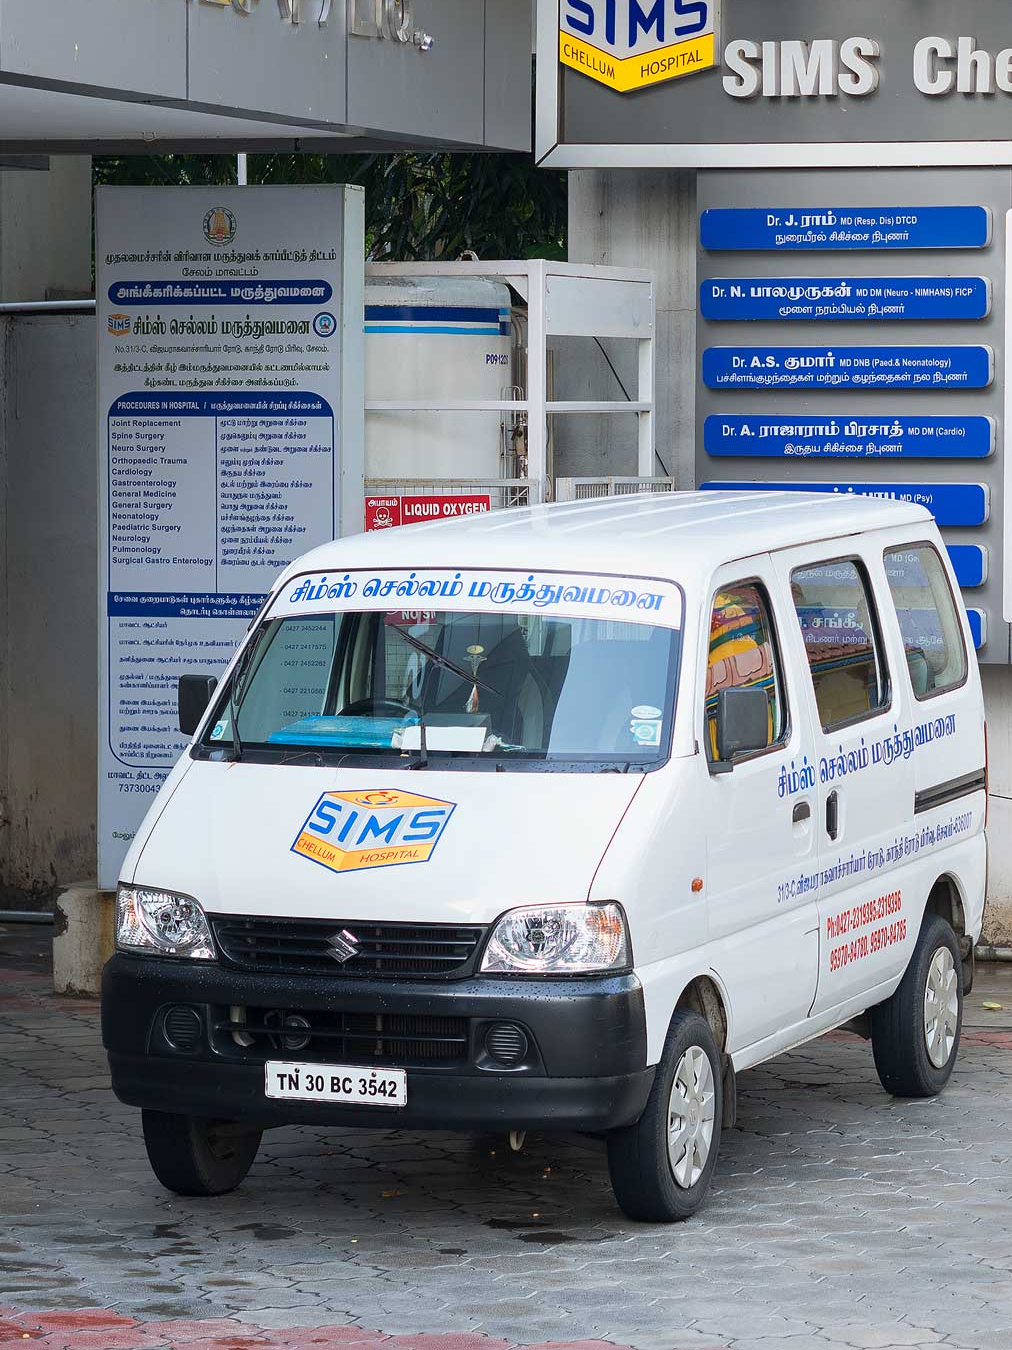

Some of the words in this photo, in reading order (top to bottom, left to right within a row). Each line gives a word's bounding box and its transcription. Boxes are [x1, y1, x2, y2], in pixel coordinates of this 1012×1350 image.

[563, 44, 615, 79] CHELLUM
[640, 50, 703, 78] HOSPITAL
[722, 36, 880, 99] SIMS
[768, 215, 781, 226] Dr.
[785, 215, 798, 226] J.
[800, 211, 836, 227] ராம்
[841, 217, 852, 225] MD
[855, 217, 877, 226] (Resp.
[880, 217, 894, 226] Dis)
[896, 216, 917, 224] DTCD
[829, 231, 869, 241] சிகிச்சை
[872, 231, 909, 244] நிபுணர்
[182, 267, 213, 276] சேலம்
[216, 266, 258, 276] மாவட்டம்
[231, 285, 325, 301] மருத்துவமனை
[107, 320, 131, 330] SIMS
[133, 315, 166, 335] சிம்ஸ்
[170, 315, 217, 335] செல்லம்
[222, 314, 310, 339] மருத்துவமனை
[733, 357, 747, 367] Dr.
[751, 356, 779, 367] A.S.
[785, 352, 835, 369] குமார்
[903, 358, 951, 368] Neonatology)
[133, 420, 180, 428] Replacement
[723, 425, 736, 435] Dr.
[740, 425, 754, 435] A.
[760, 421, 839, 437] ராஜாராம்
[845, 420, 903, 438] பிரசாத்
[936, 428, 965, 437] (Cardio)
[112, 432, 133, 440] Spine
[137, 445, 165, 453] Surgery
[823, 443, 863, 452] சிகிச்சை
[866, 442, 902, 455] நிபுணர்
[112, 457, 157, 465] Orthopaedic
[112, 468, 152, 476] Cardiology
[112, 480, 176, 488] Gastroenterology
[900, 494, 911, 502] MD
[914, 494, 933, 503] (Psy)
[143, 502, 172, 510] Surgery
[405, 504, 439, 516] LIQUID
[443, 503, 486, 515] OXYGEN
[112, 513, 159, 521] Neonatology
[152, 524, 181, 532] Surgery
[113, 535, 150, 543] Neurology
[113, 546, 161, 554] Pulmonology
[113, 557, 143, 565] Surgical
[173, 557, 213, 566] Enterology
[289, 576, 357, 603] சிம்ஸ்
[362, 573, 463, 599] செல்லம்
[468, 576, 665, 612] மருத்துவமனை
[777, 756, 816, 799] சிம்ஸ்
[820, 738, 868, 783] செல்லம்
[871, 714, 956, 766] மருத்துவமனை
[308, 800, 446, 846] SIMS
[297, 836, 336, 863] CHELLUM
[359, 849, 420, 865] HOSPITAL
[276, 1072, 299, 1091] TN
[305, 1074, 324, 1092] 30
[330, 1077, 353, 1095] BC
[358, 1078, 397, 1098] 3542
